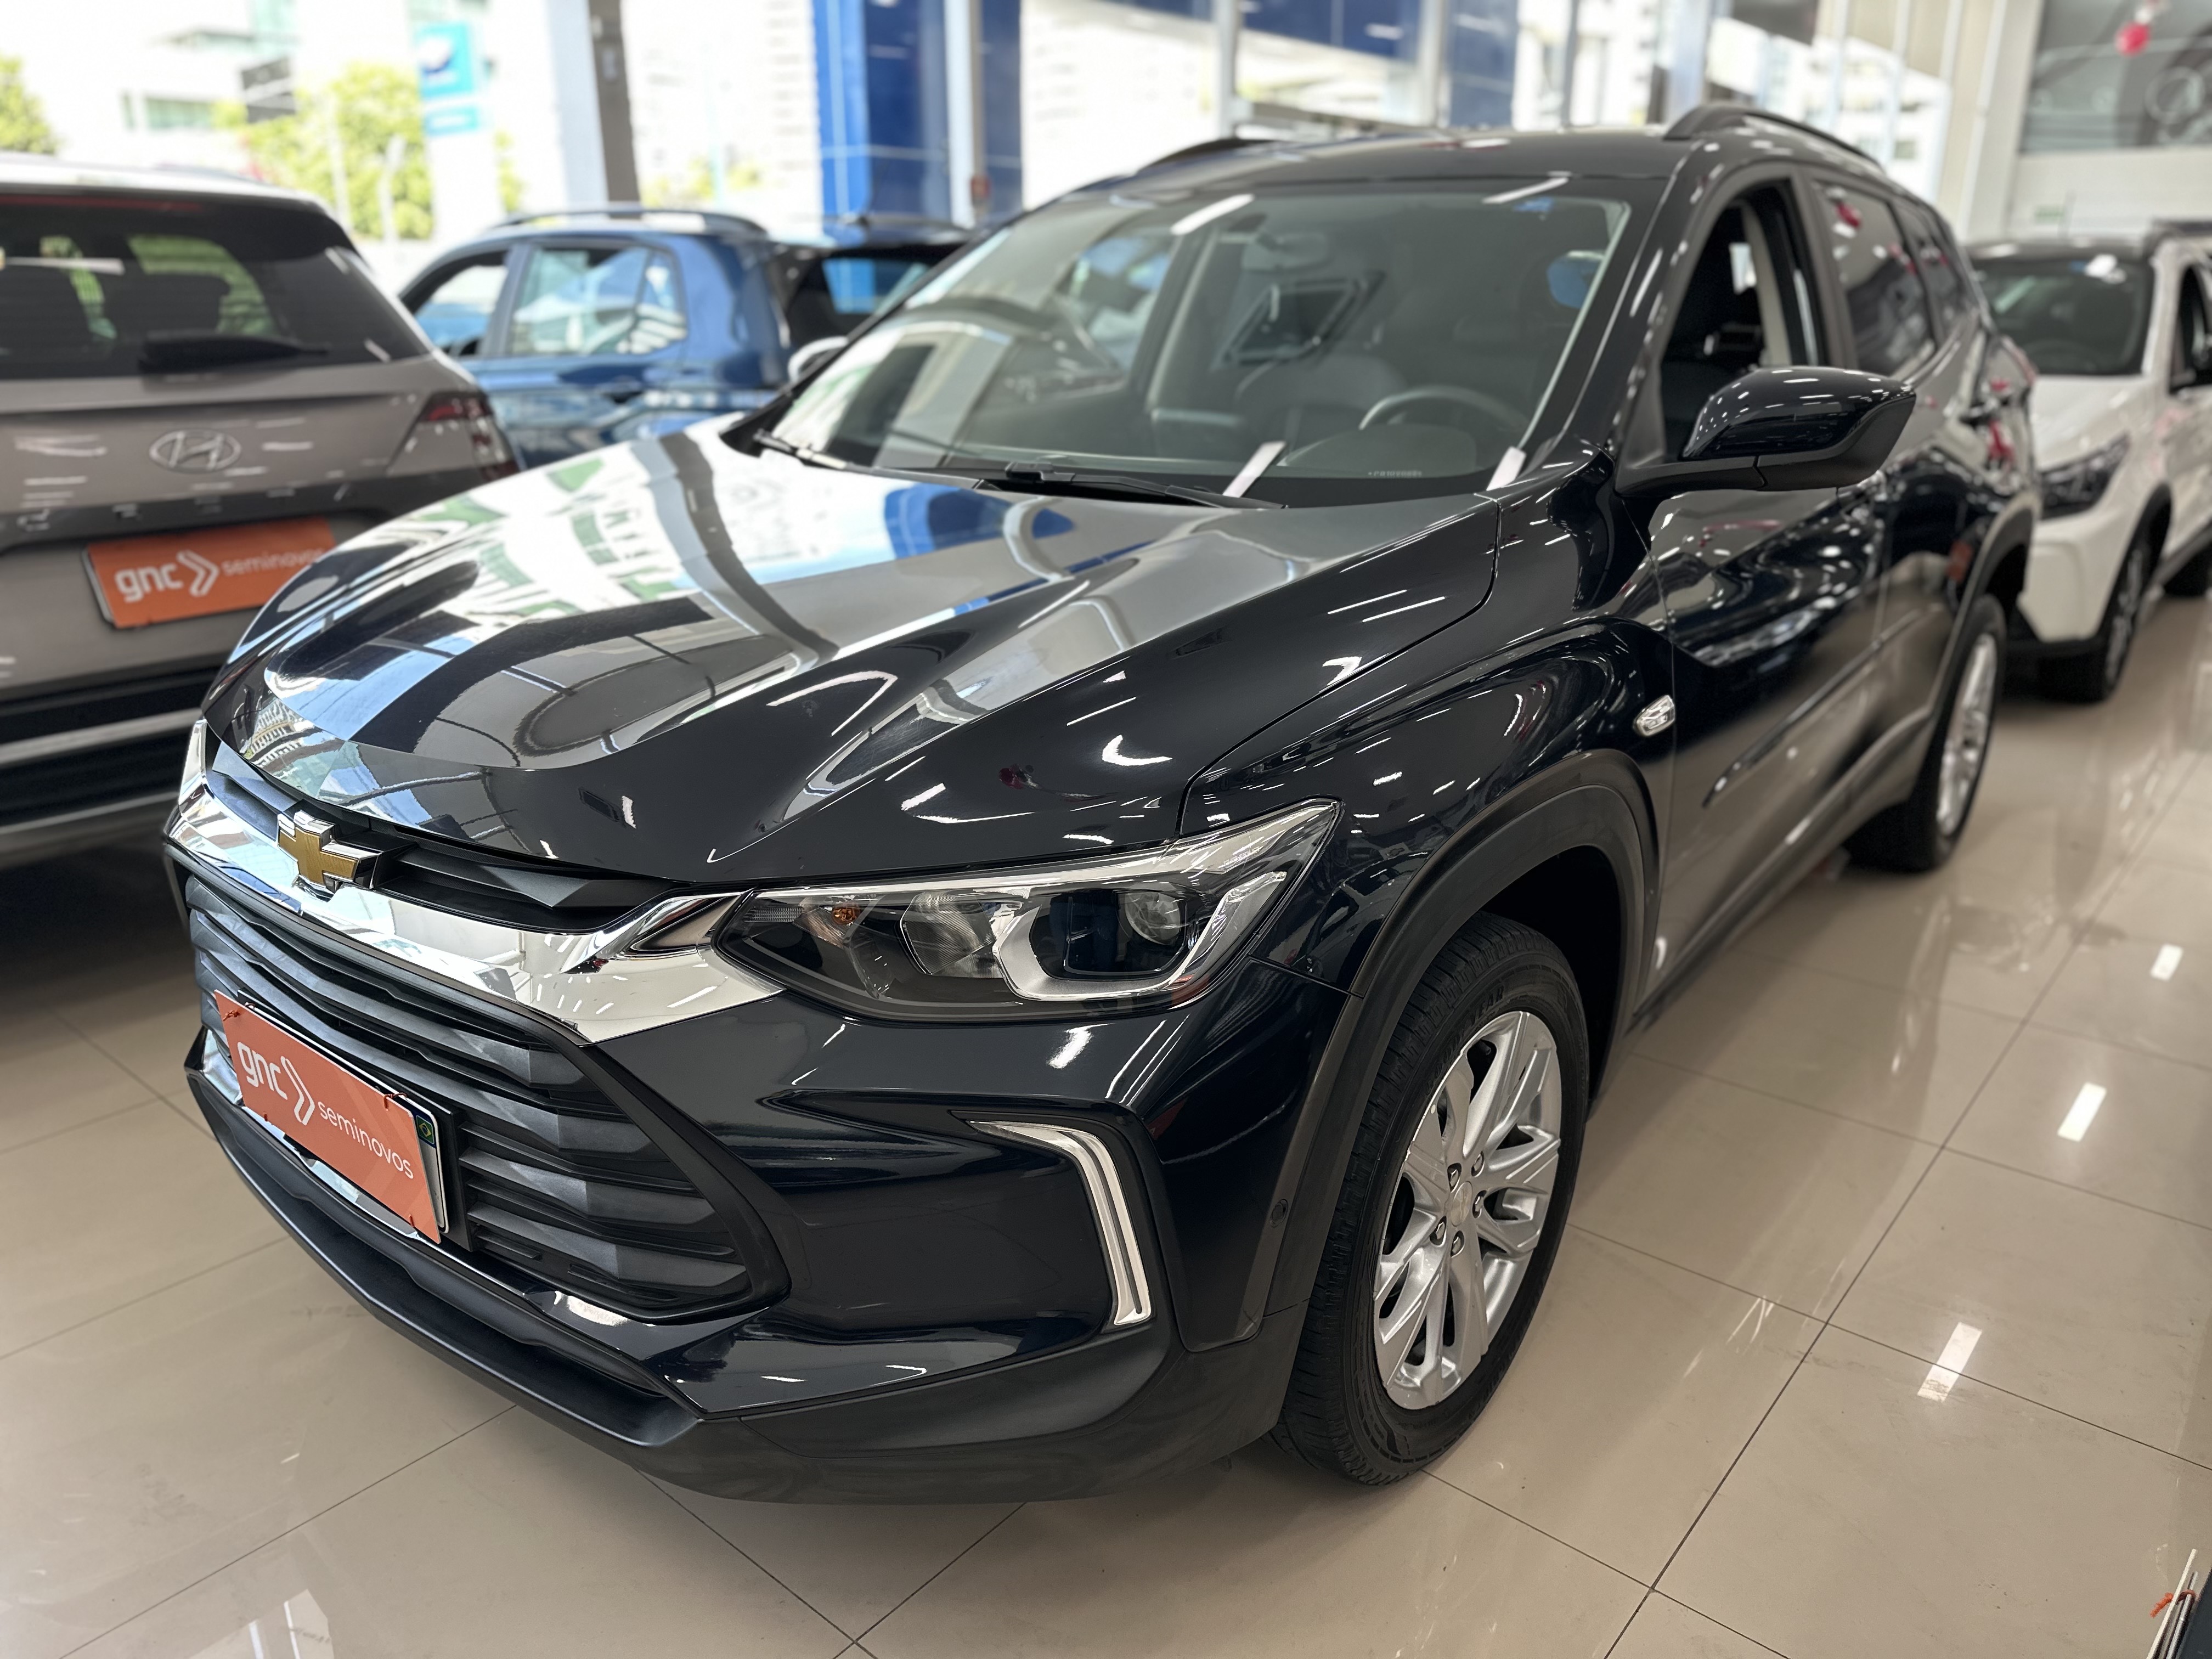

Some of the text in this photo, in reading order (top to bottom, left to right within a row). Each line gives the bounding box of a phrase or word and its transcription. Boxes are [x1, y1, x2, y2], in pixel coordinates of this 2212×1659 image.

[115, 563, 184, 604] gnc
[238, 1042, 414, 1179] gnc seminovos
